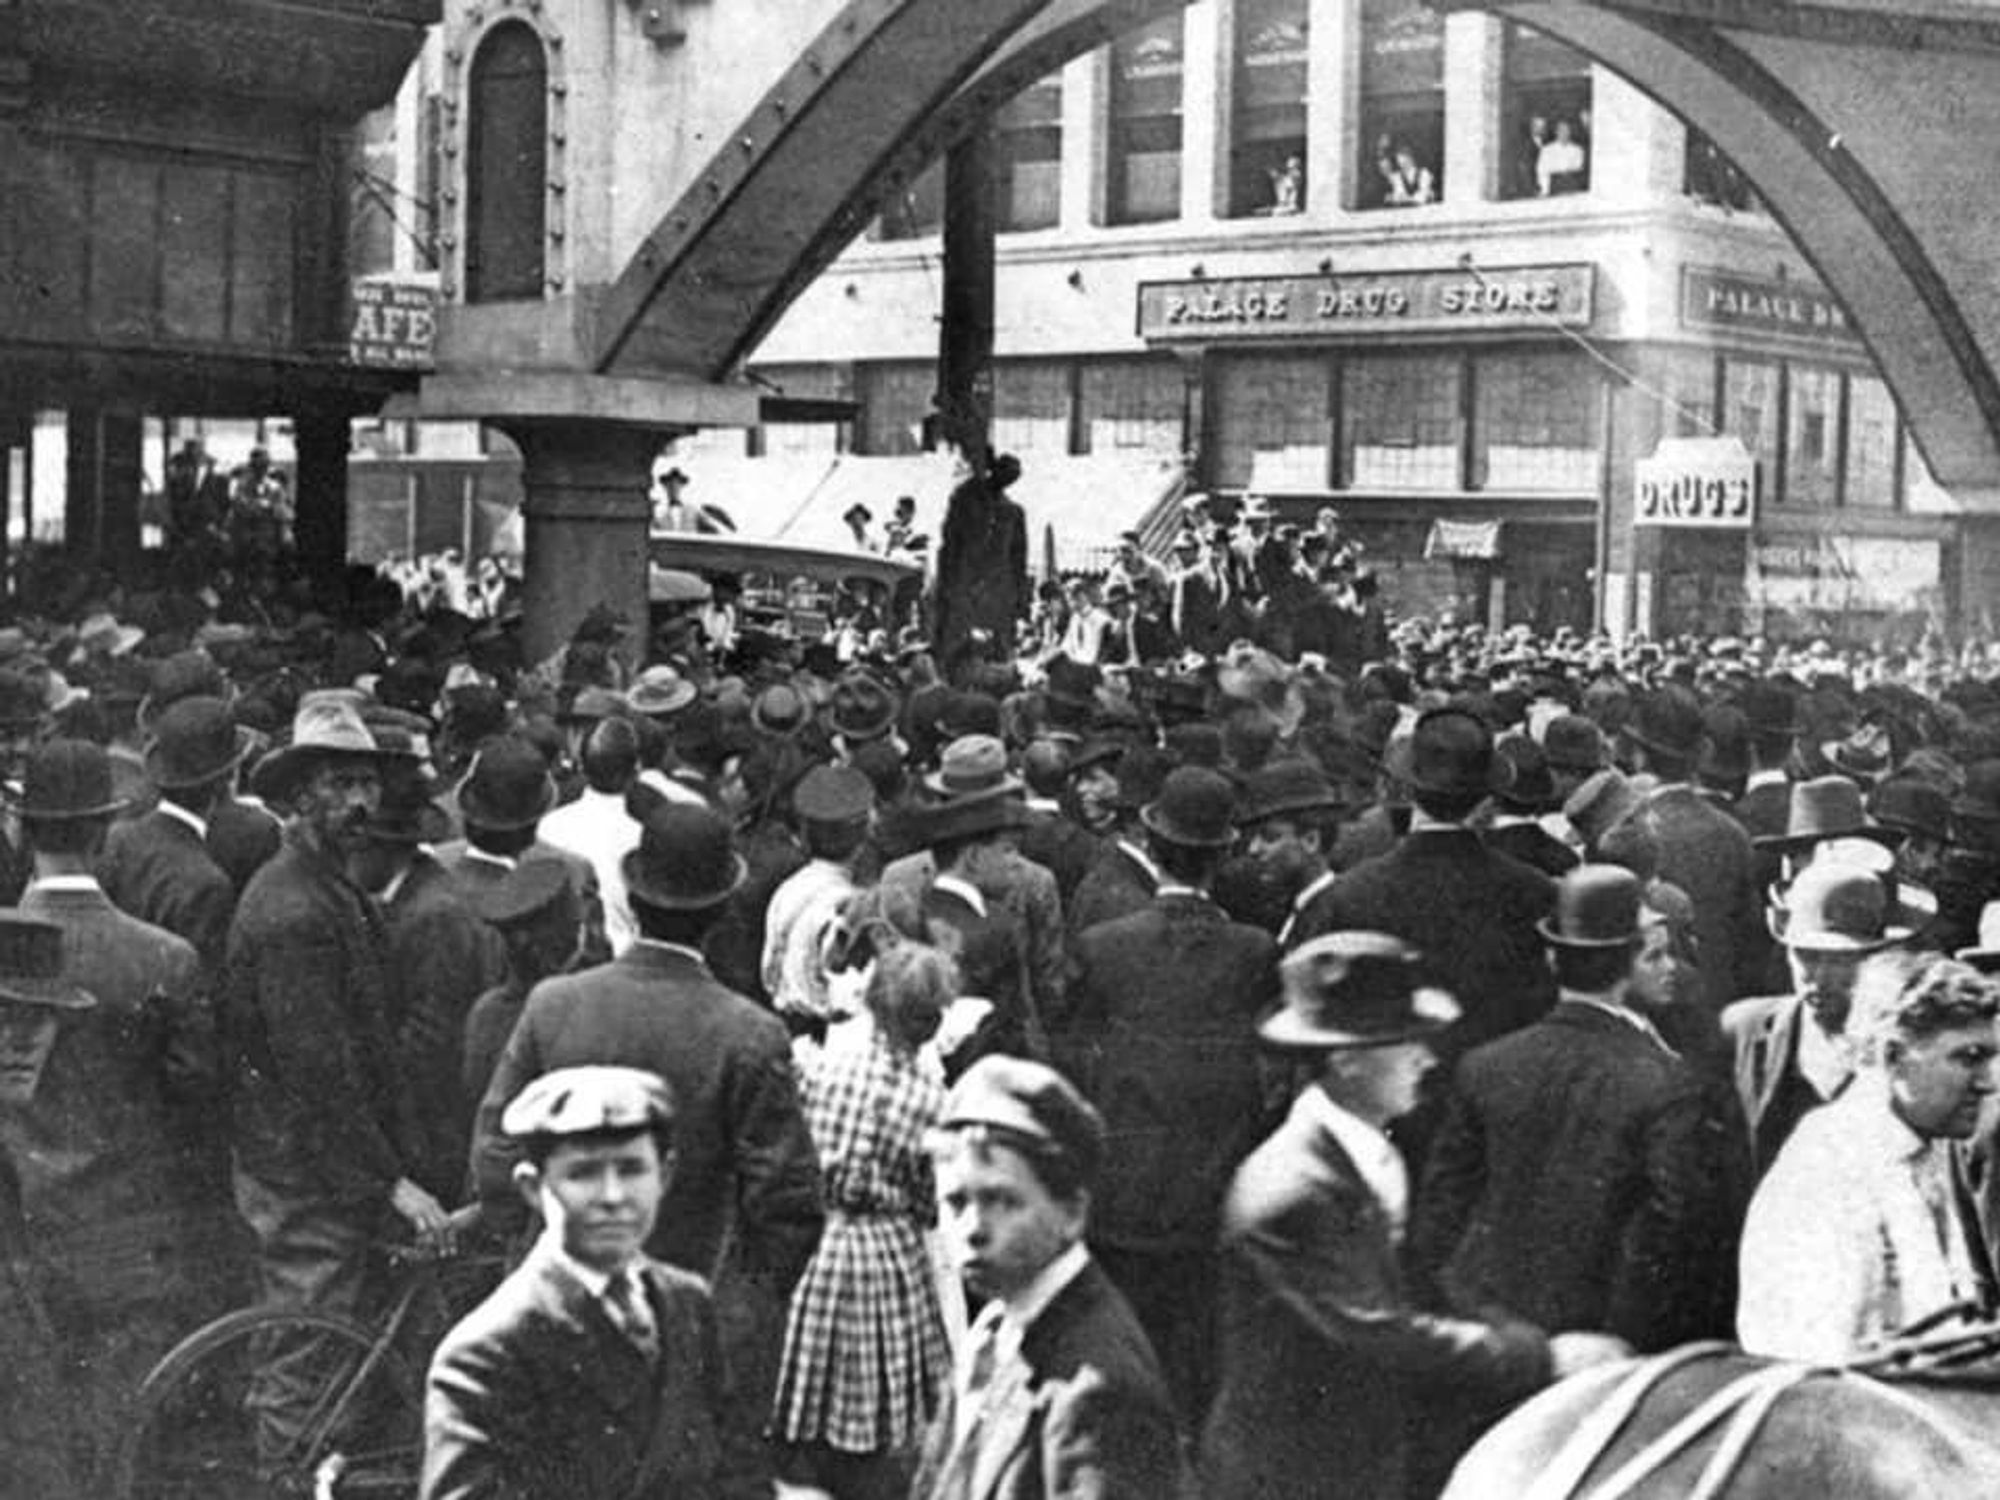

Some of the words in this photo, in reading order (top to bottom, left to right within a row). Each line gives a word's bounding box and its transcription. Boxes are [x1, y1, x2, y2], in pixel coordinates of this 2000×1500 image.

[1166, 292, 1288, 325] PALACE
[1316, 289, 1409, 318] DRUG
[1441, 281, 1559, 315] STORE
[1707, 287, 1803, 323] PALACE
[1811, 300, 1845, 328] DR
[351, 304, 431, 345] AFE
[1640, 474, 1749, 518] DRUGS
